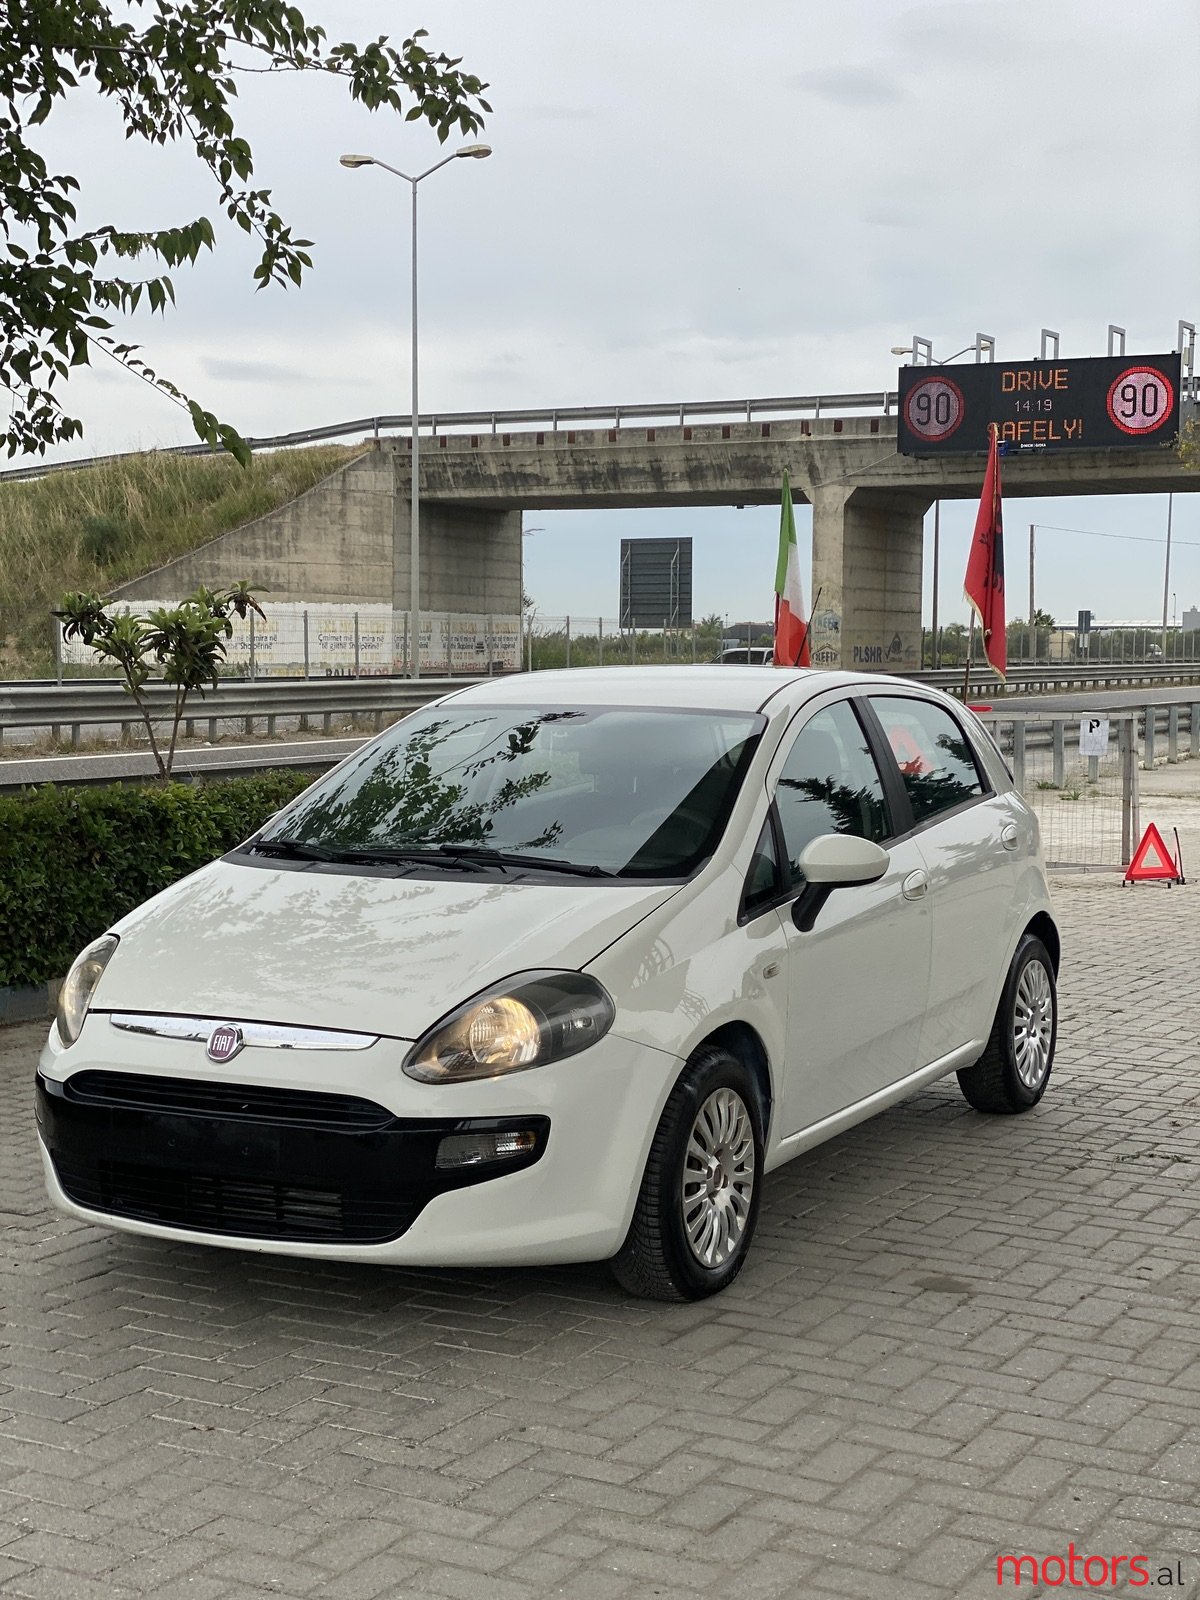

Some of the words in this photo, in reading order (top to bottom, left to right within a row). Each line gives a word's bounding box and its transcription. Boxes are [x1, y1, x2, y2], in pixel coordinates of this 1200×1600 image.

[1001, 369, 1069, 392] DRIVE
[916, 392, 951, 426] 90
[1014, 399, 1053, 413] 14:19
[1120, 383, 1158, 418] 90
[853, 645, 882, 663] PLSHR
[1089, 719, 1100, 733] P
[212, 1034, 233, 1052] FIAT
